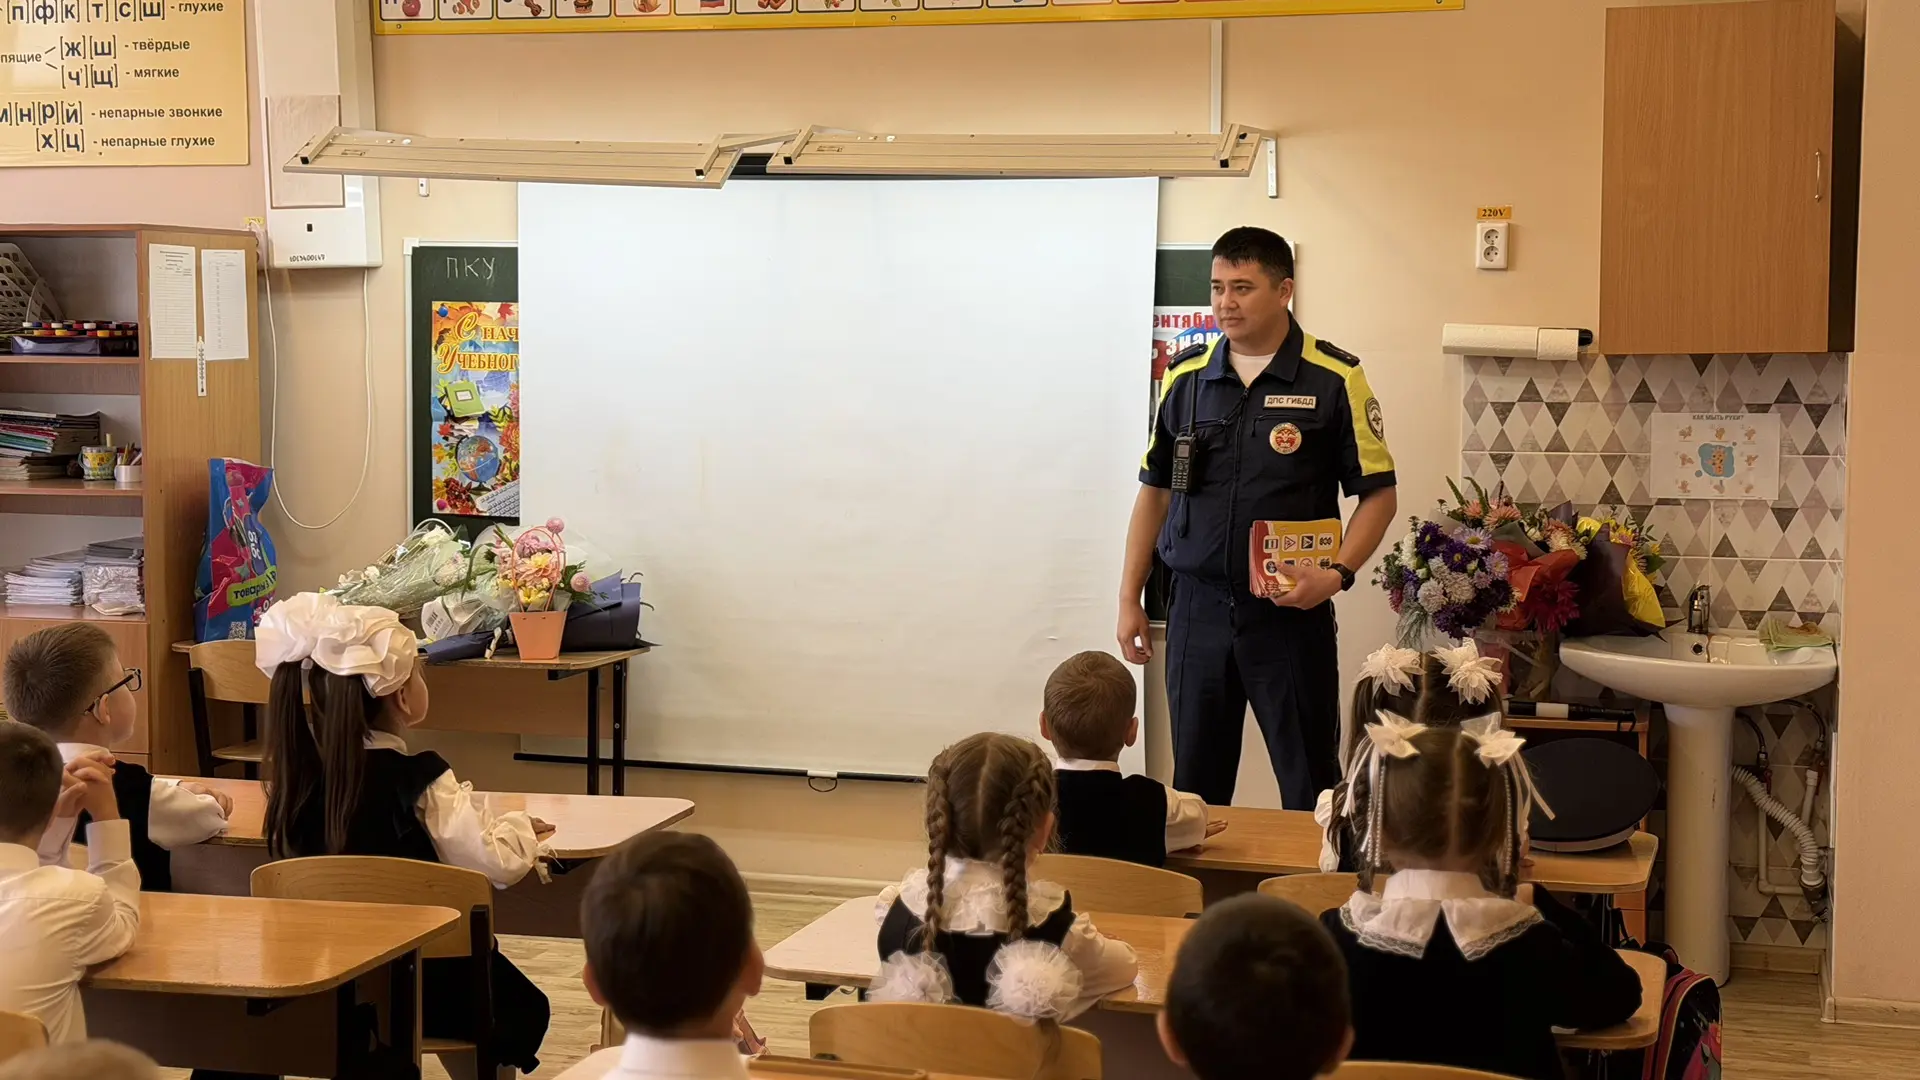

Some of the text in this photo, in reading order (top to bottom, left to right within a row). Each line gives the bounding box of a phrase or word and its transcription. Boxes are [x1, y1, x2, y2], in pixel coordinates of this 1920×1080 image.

[179, 2, 224, 14] глухие
[132, 38, 190, 51] твёрдые
[0, 53, 42, 64] пящие
[134, 67, 180, 78] мягкие
[99, 107, 165, 120] непарные
[169, 106, 223, 118] звонкие
[101, 136, 166, 149] непарные
[171, 136, 215, 148] глухие
[1482, 208, 1507, 217] 220V
[446, 257, 495, 279] ПКУ
[455, 312, 478, 341] С
[1286, 397, 1314, 406] ГИБДД
